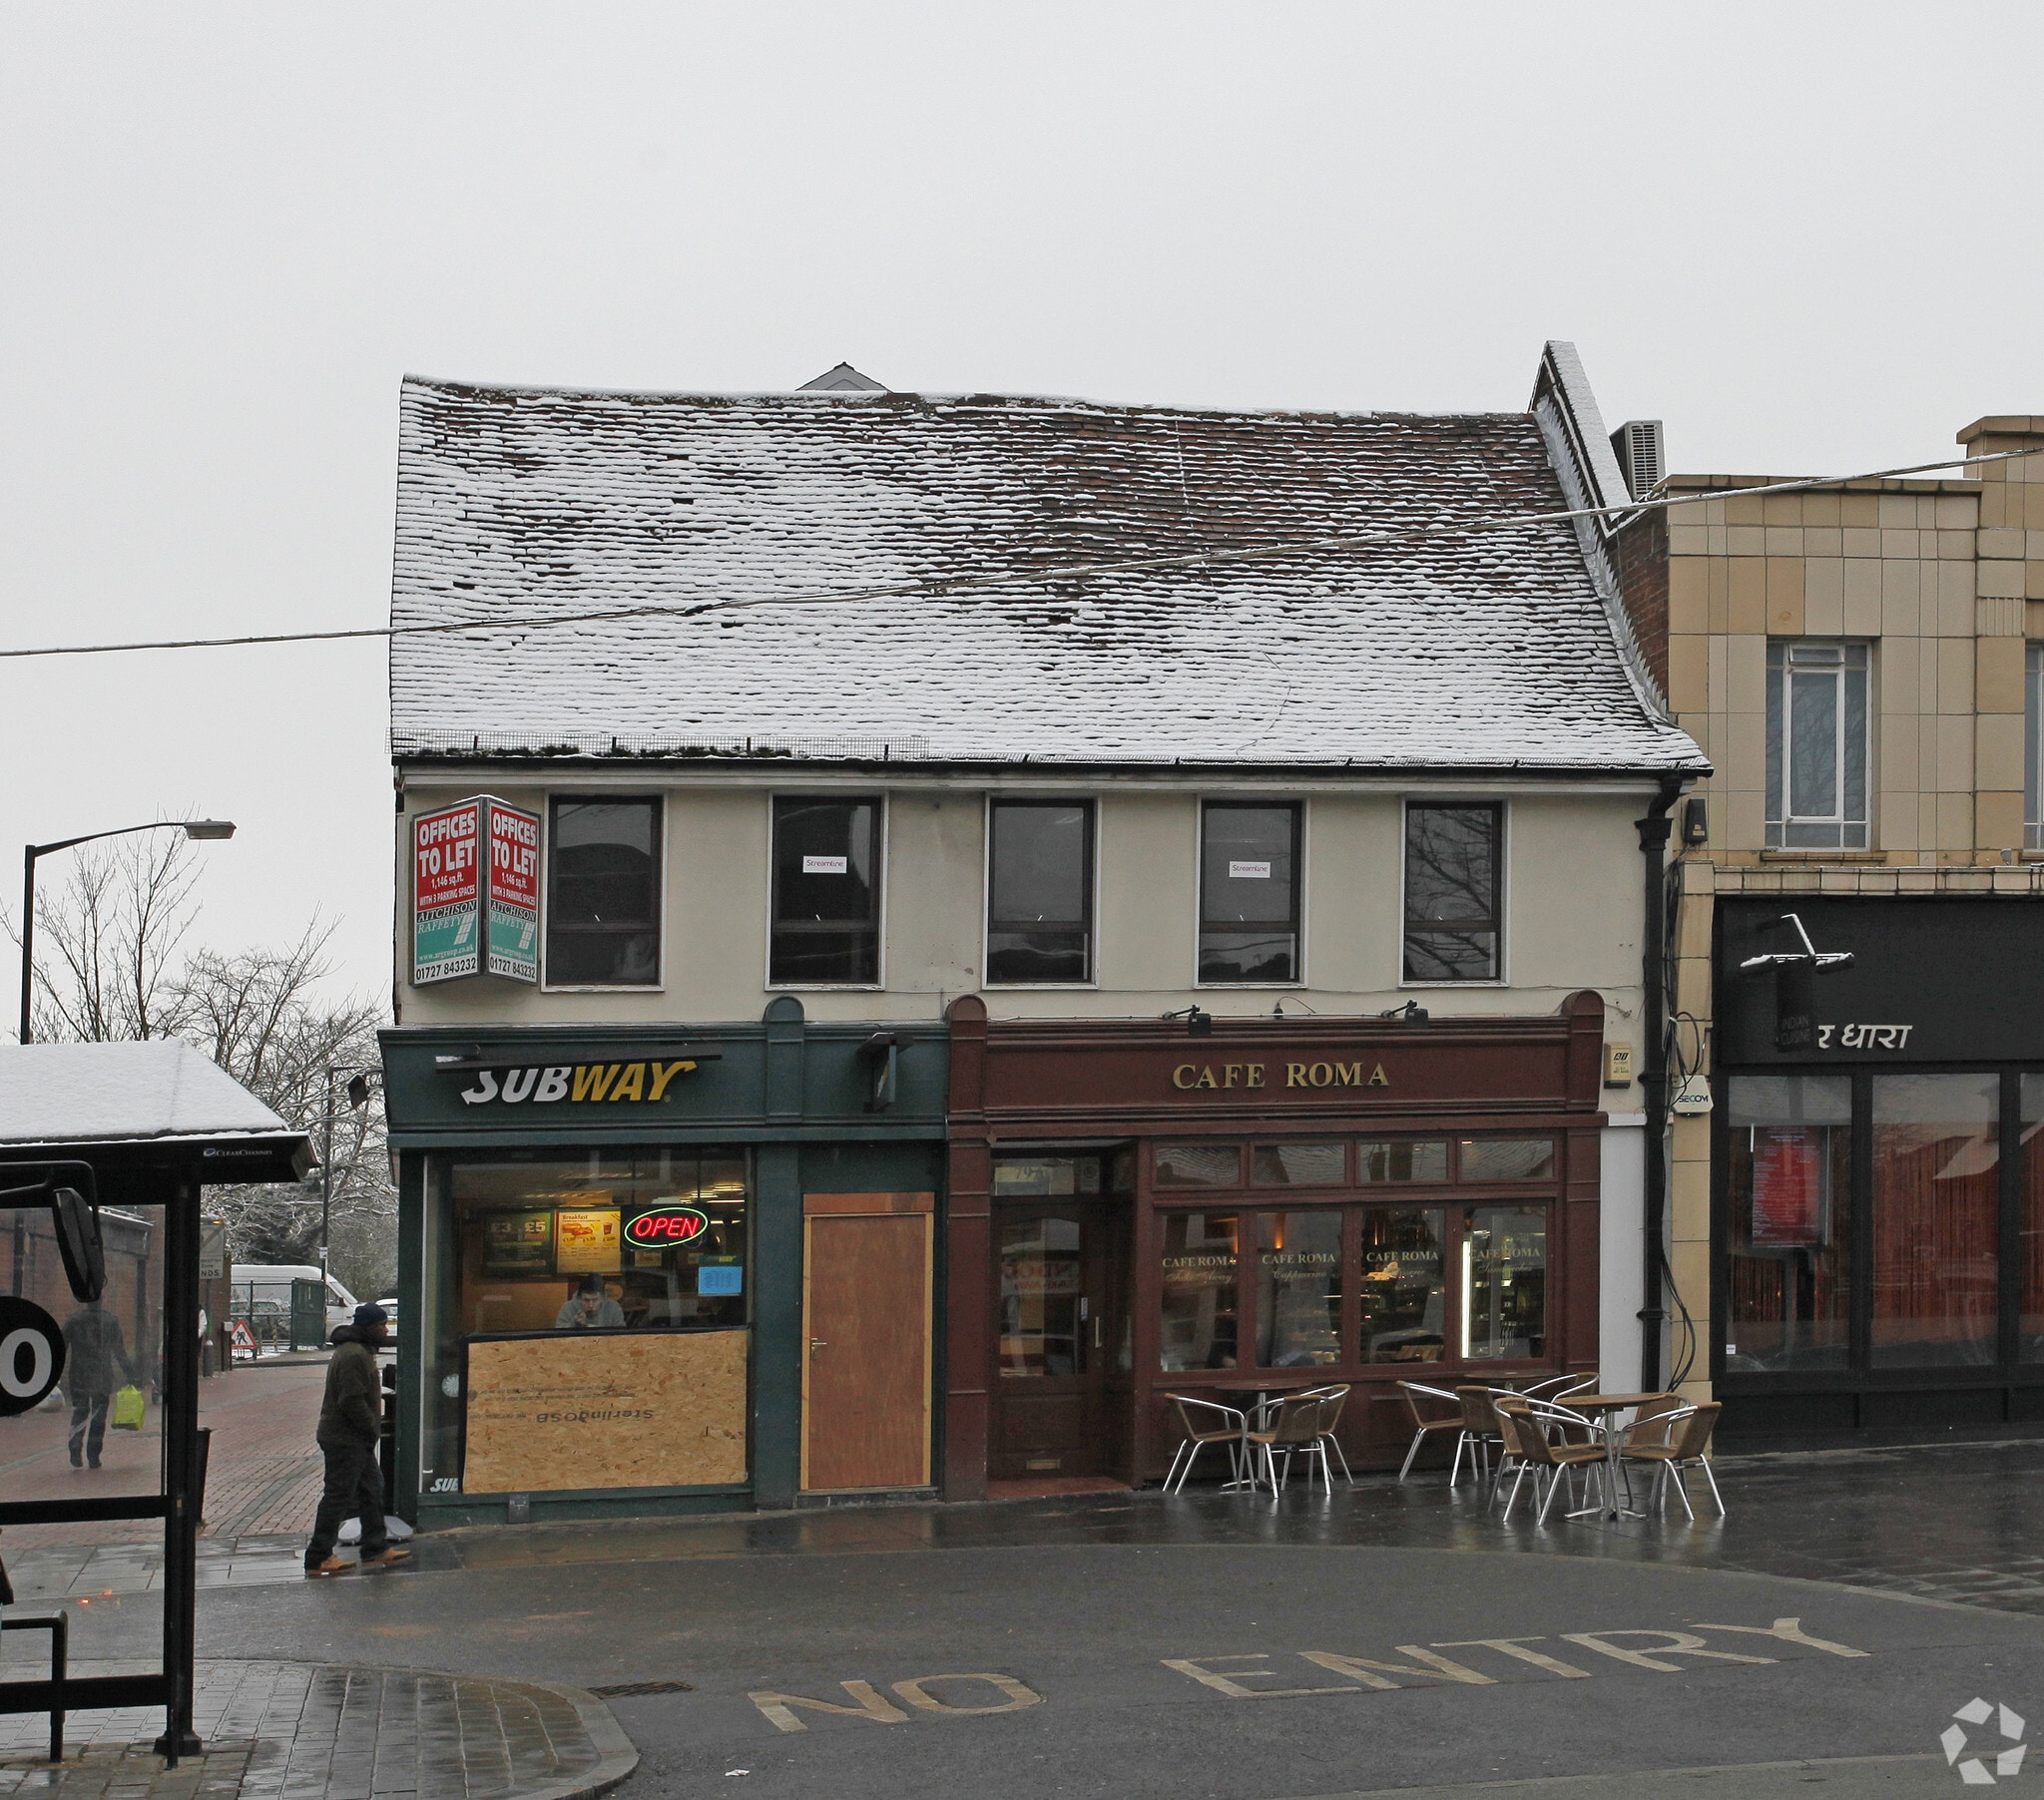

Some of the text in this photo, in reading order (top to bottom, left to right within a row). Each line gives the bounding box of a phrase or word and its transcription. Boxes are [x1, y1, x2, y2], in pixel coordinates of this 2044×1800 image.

[419, 811, 476, 847] OFFICES
[492, 812, 536, 847] OFFICES
[419, 838, 476, 877] TO LET
[492, 839, 536, 877] TO LET
[431, 875, 448, 889] 1,146
[501, 872, 515, 886] 1,146
[419, 895, 432, 906] WITH
[437, 888, 458, 903] PARKING
[458, 885, 475, 898] SPACES
[492, 885, 502, 896] WITH
[506, 888, 522, 903] PARKING
[522, 894, 536, 906] SPACES
[418, 901, 476, 922] AITCHISON
[491, 901, 536, 922] AITCHISON
[491, 911, 525, 930] RAFFETY
[418, 915, 463, 934] RAFFETY
[416, 957, 476, 981] 01727 843232
[490, 956, 536, 979] 01727 843232
[1841, 1024, 1913, 1049] धारा
[460, 1061, 697, 1105] SUBWAY
[1173, 1063, 1390, 1089] CAFE ROMA
[524, 1221, 546, 1233] £5
[633, 1216, 701, 1238] OPEN
[1162, 1257, 1196, 1268] CAFE
[1262, 1253, 1335, 1265] CAFE ROMA
[1366, 1250, 1438, 1262] CAFE ROMA
[1469, 1249, 1499, 1260] CAFE
[748, 1618, 1872, 1732] NO ENTRY
